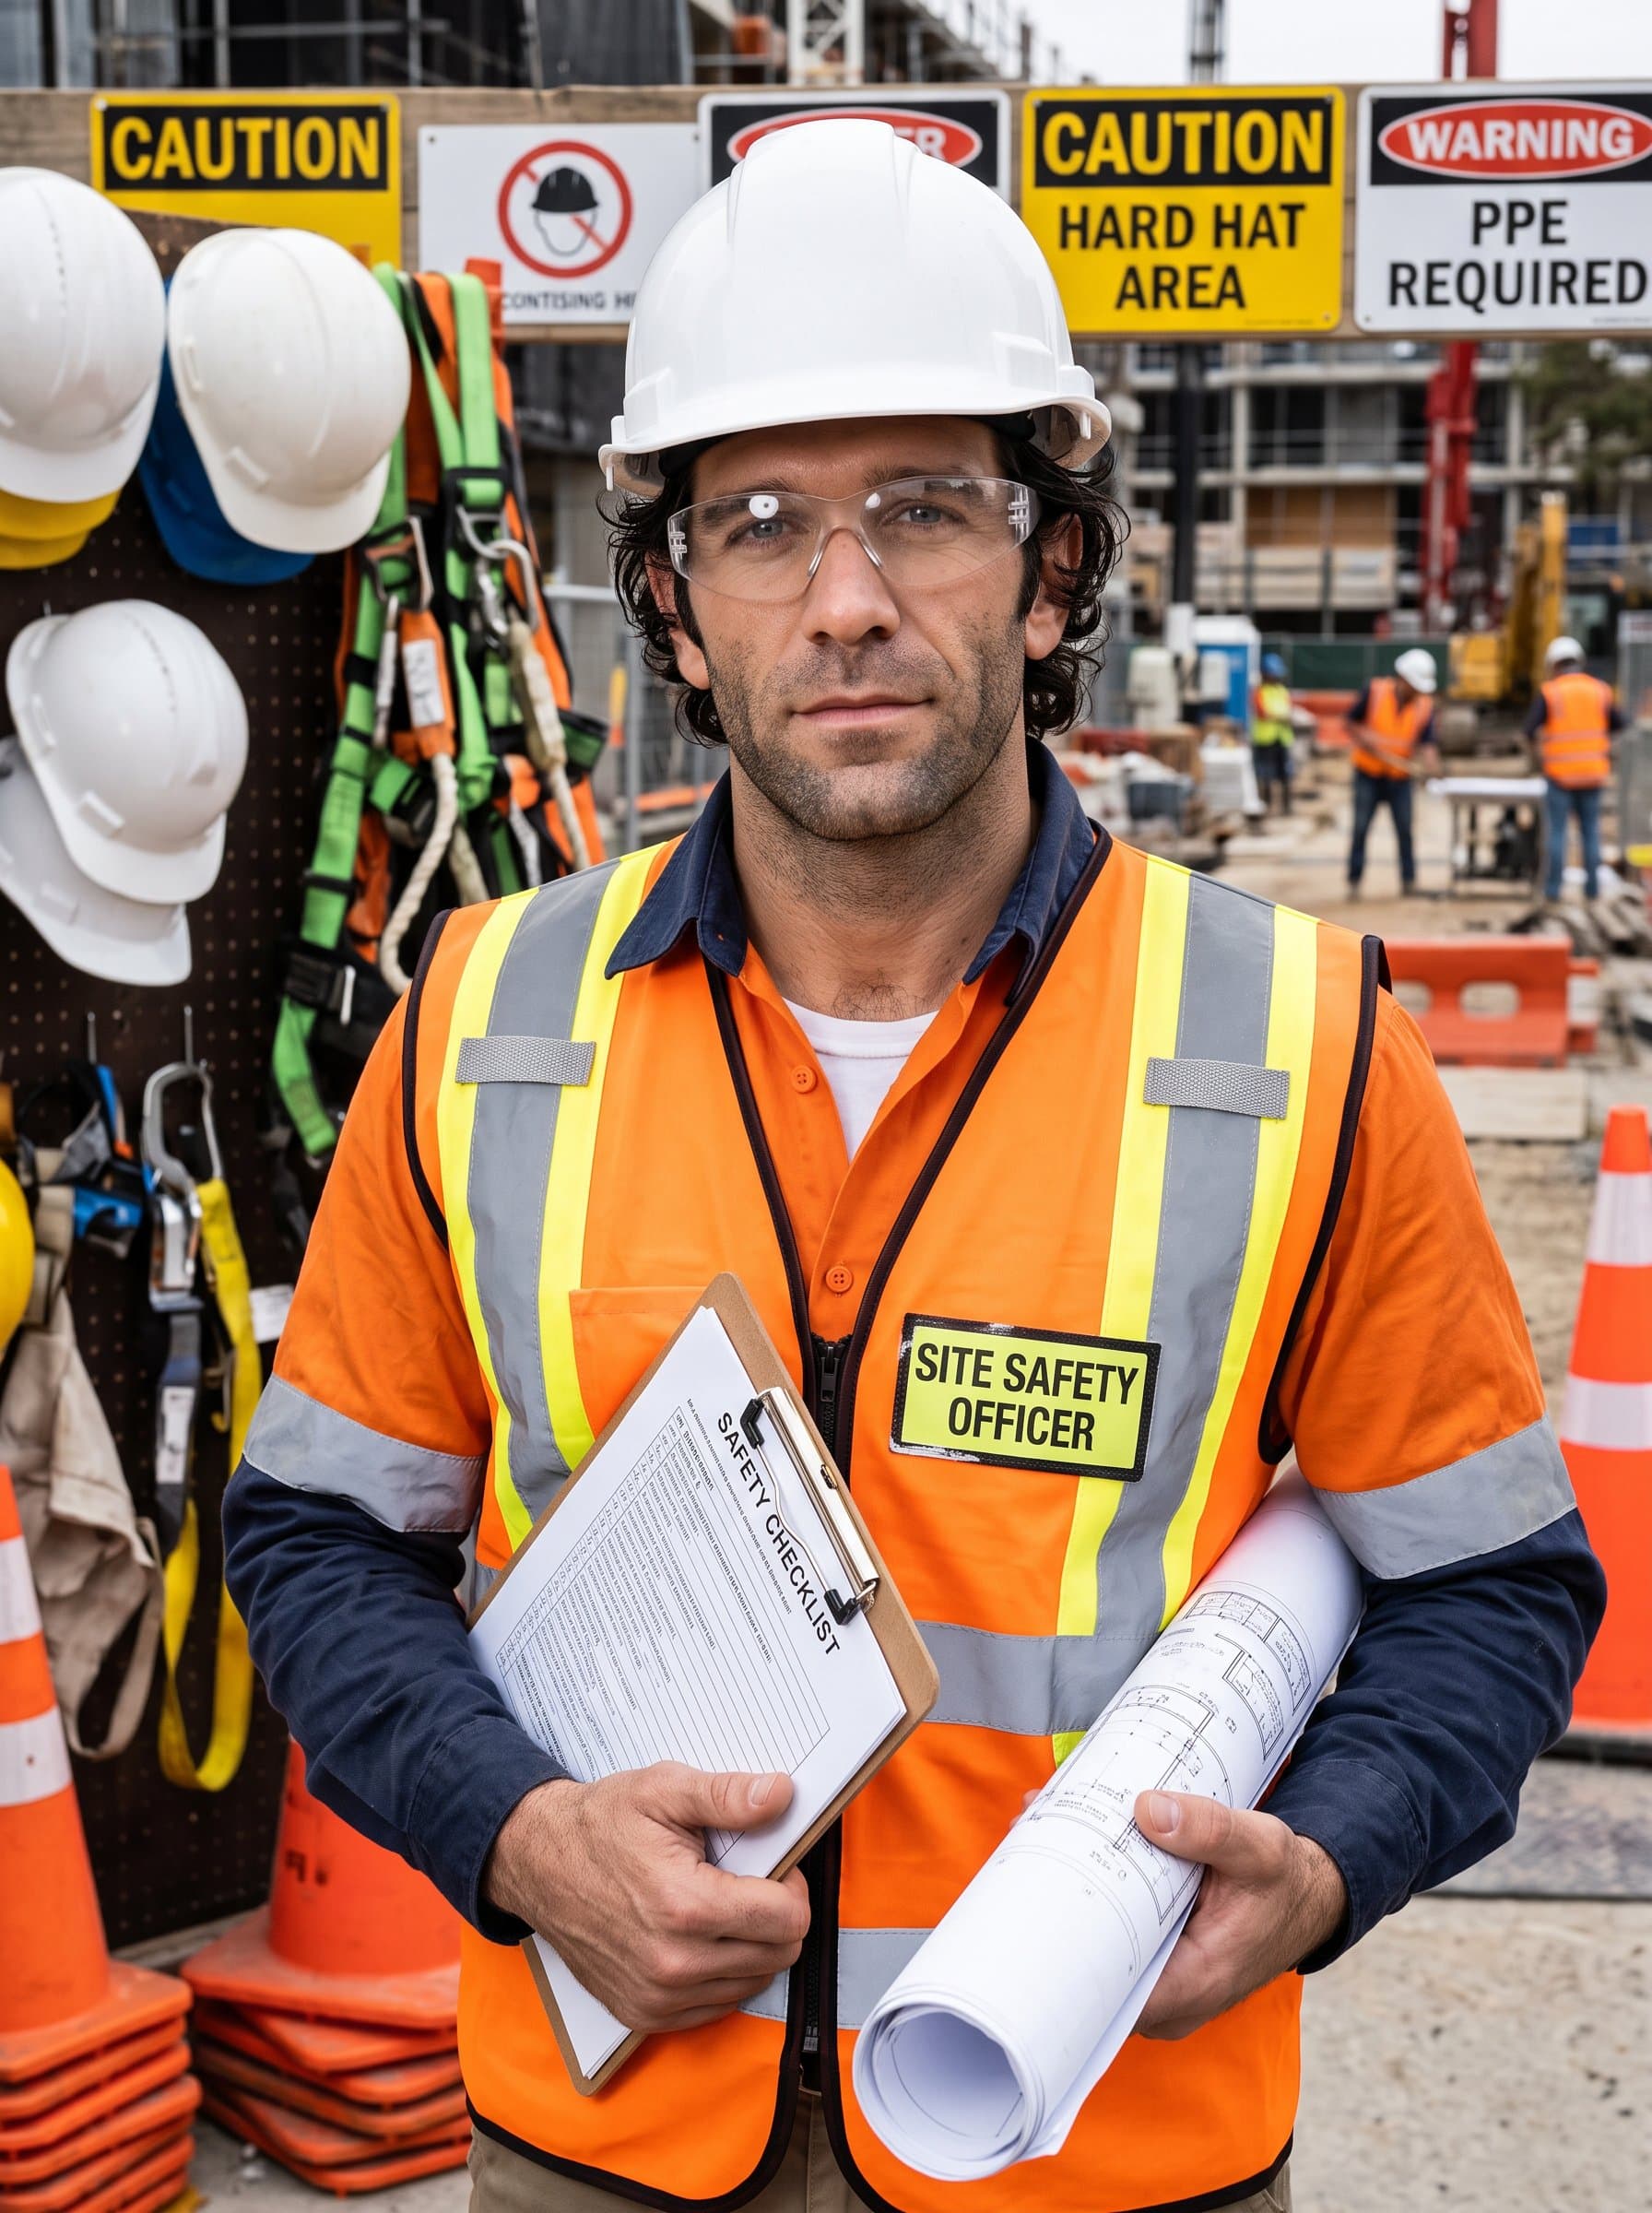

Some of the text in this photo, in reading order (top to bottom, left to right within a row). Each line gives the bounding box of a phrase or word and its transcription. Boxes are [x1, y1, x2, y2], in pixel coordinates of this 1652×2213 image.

[110, 116, 380, 181] CAUTION
[1043, 110, 1324, 176] CAUTION
[1408, 117, 1634, 160] WARNING
[1059, 203, 1306, 250] HARD HAT
[1472, 200, 1568, 245] PPE
[1115, 265, 1246, 310] AREA
[1389, 260, 1648, 314] REQUIRED
[914, 1342, 1140, 1405] SITE SAFETY
[948, 1396, 1096, 1452] OFFICER
[717, 1412, 772, 1509] SAFETY
[765, 1513, 841, 1655] CHECKLIST
